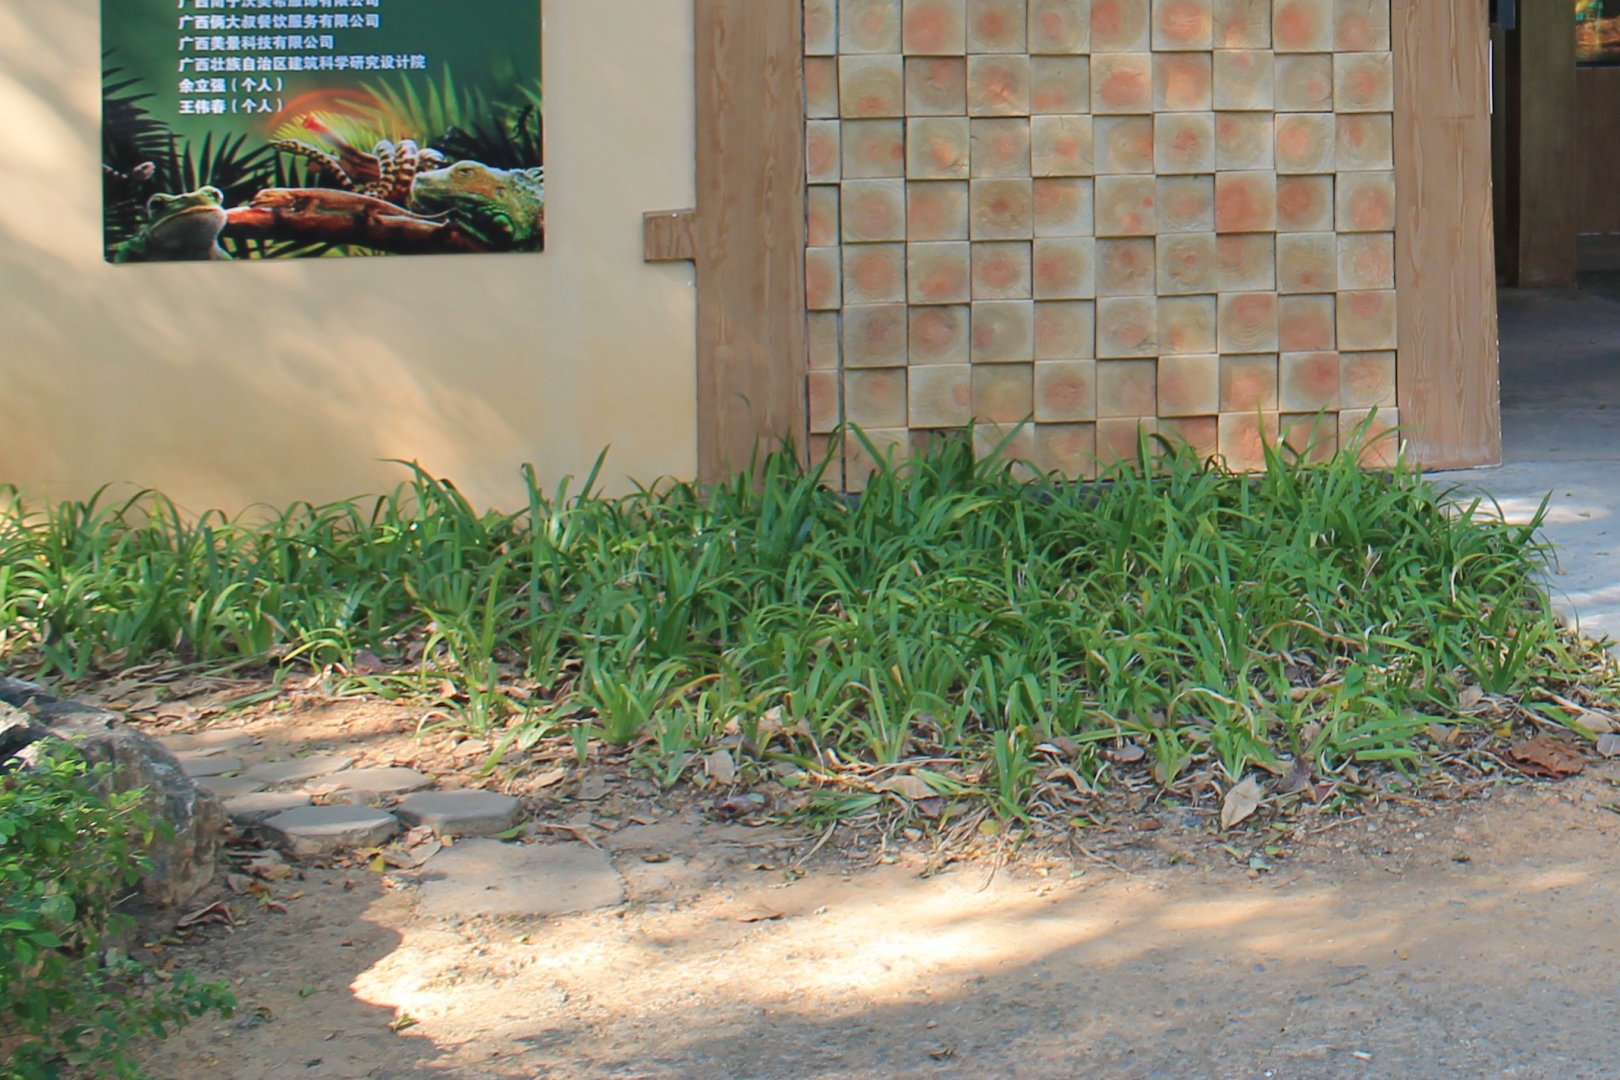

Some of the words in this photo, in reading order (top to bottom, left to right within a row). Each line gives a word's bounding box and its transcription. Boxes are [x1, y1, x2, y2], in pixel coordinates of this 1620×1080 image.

[177, 55, 426, 72] 广西壮族自治区建筑科学研究设计院
